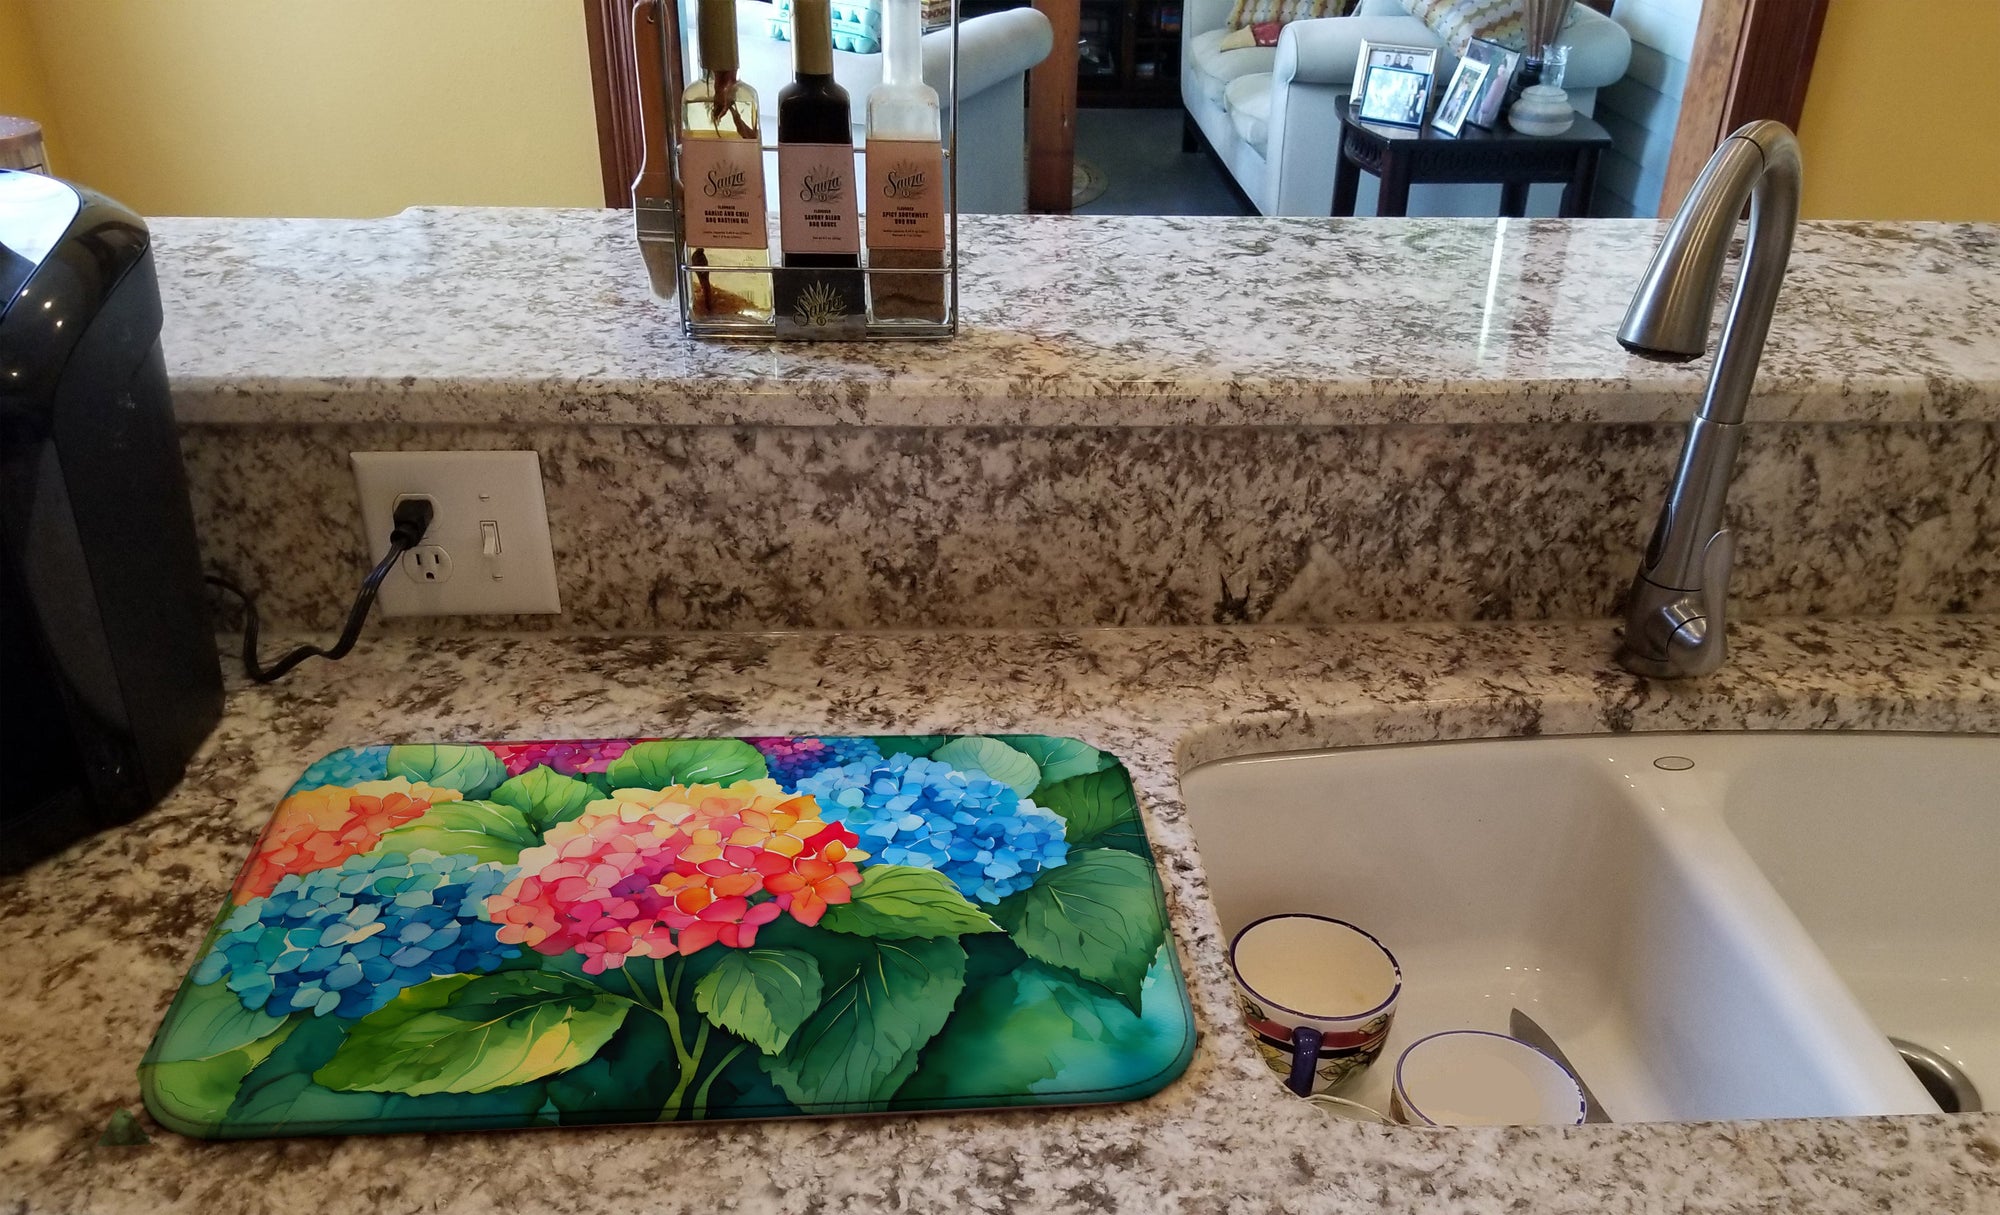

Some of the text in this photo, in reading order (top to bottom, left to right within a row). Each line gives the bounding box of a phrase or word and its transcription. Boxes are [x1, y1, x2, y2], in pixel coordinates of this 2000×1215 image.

[704, 170, 746, 197] Sauza
[800, 175, 842, 202] Sauza
[883, 171, 926, 198] Sauza
